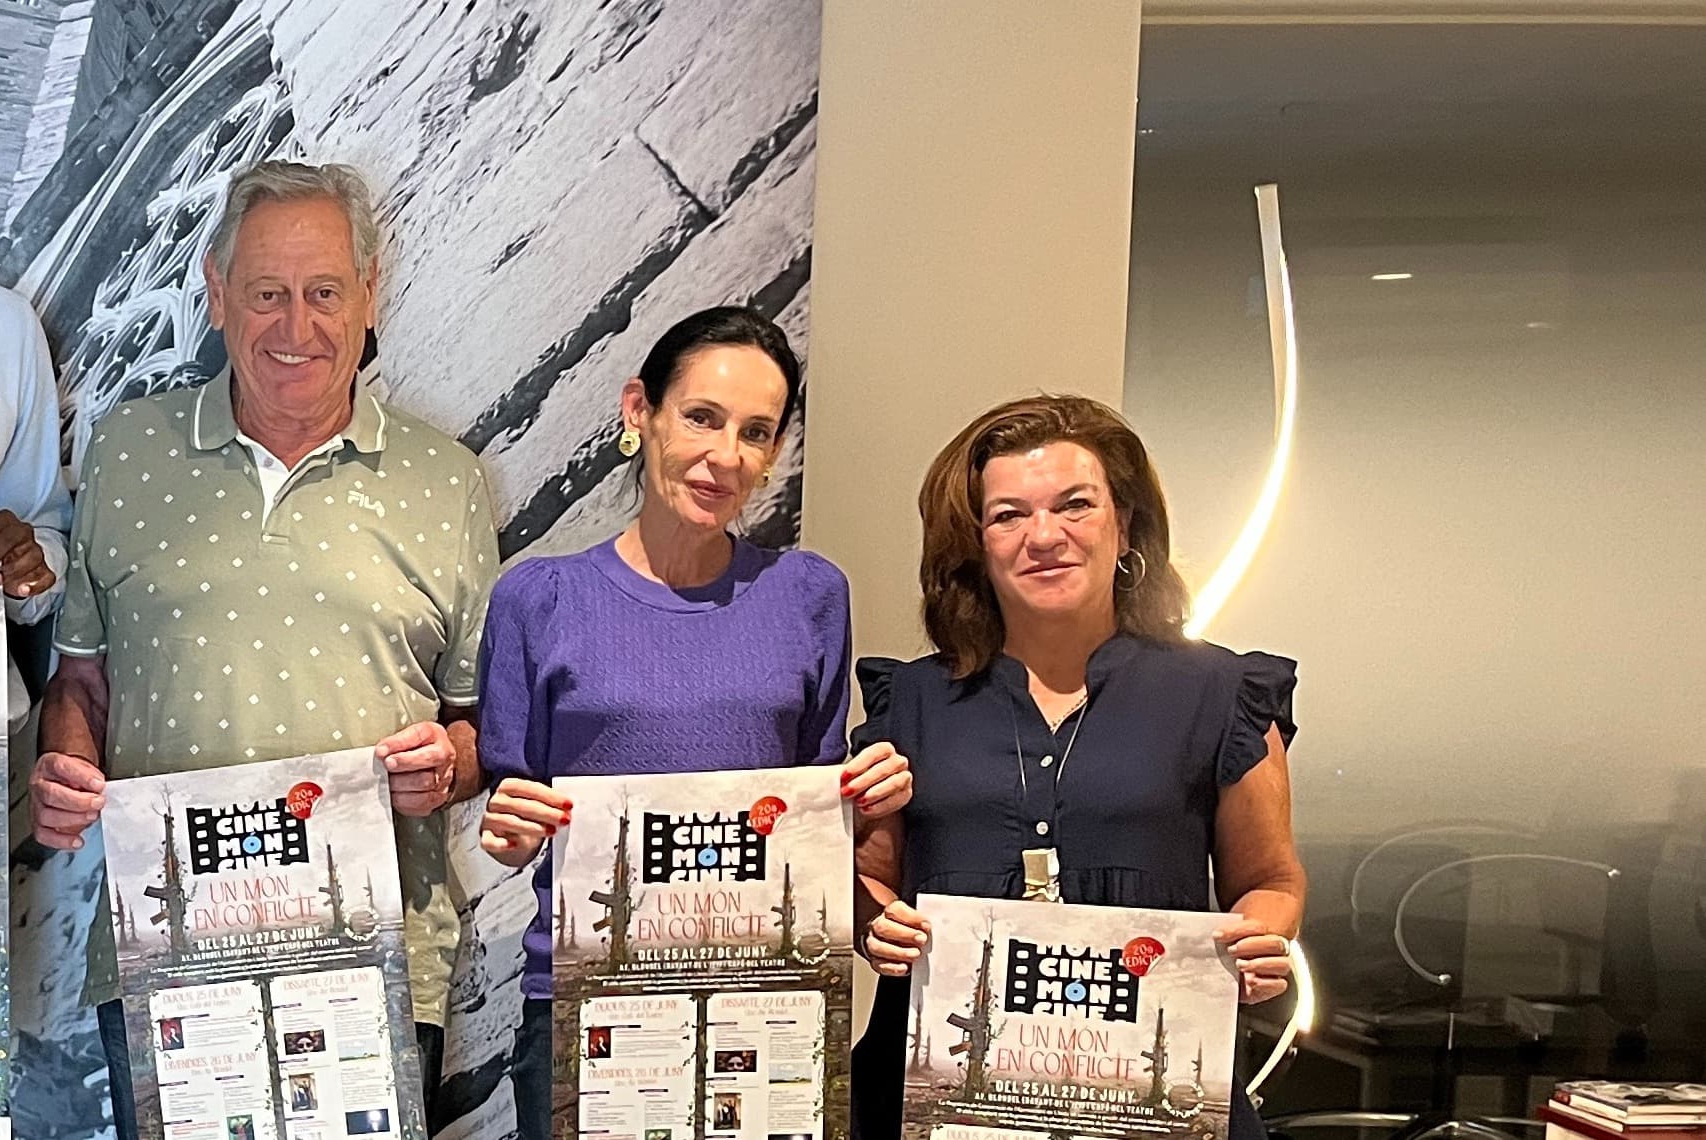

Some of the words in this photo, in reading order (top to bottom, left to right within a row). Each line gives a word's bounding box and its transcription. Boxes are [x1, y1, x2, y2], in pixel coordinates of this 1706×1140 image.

[347, 490, 385, 518] FILA
[216, 811, 281, 836] CINE
[673, 825, 740, 845] CINE
[217, 829, 283, 858] MÓN
[672, 843, 741, 867] MÓN
[209, 881, 237, 904] UN
[243, 871, 290, 900] MÓN
[194, 907, 217, 930] EN
[222, 896, 318, 928] CONFLICTE
[657, 893, 685, 915] UN
[694, 888, 741, 914] MÓN
[197, 937, 219, 951] DEL
[221, 935, 236, 948] 25
[238, 934, 253, 946] AL
[255, 931, 270, 944] 27
[272, 929, 286, 942] DE
[289, 926, 320, 940] JUNY
[639, 918, 661, 940] EN
[669, 915, 767, 940] CONFLICTE
[637, 949, 660, 961] DEL
[663, 948, 678, 960] 25
[680, 948, 696, 959] AL
[699, 947, 713, 959] 27
[717, 946, 731, 958] DE
[734, 945, 766, 958] JUNY
[1038, 957, 1112, 981] CINE
[1037, 976, 1111, 1005] MÓN
[1018, 1024, 1049, 1048] UN
[1057, 1023, 1109, 1054] MÓN
[997, 1047, 1022, 1072] EN
[1029, 1050, 1136, 1083] CONFLICTE
[995, 1079, 1019, 1094] DEL
[1022, 1081, 1039, 1095] 25
[1040, 1083, 1057, 1096] AL
[1061, 1085, 1077, 1098] 27
[1080, 1086, 1096, 1100] DE
[1099, 1088, 1134, 1103] JUNY
